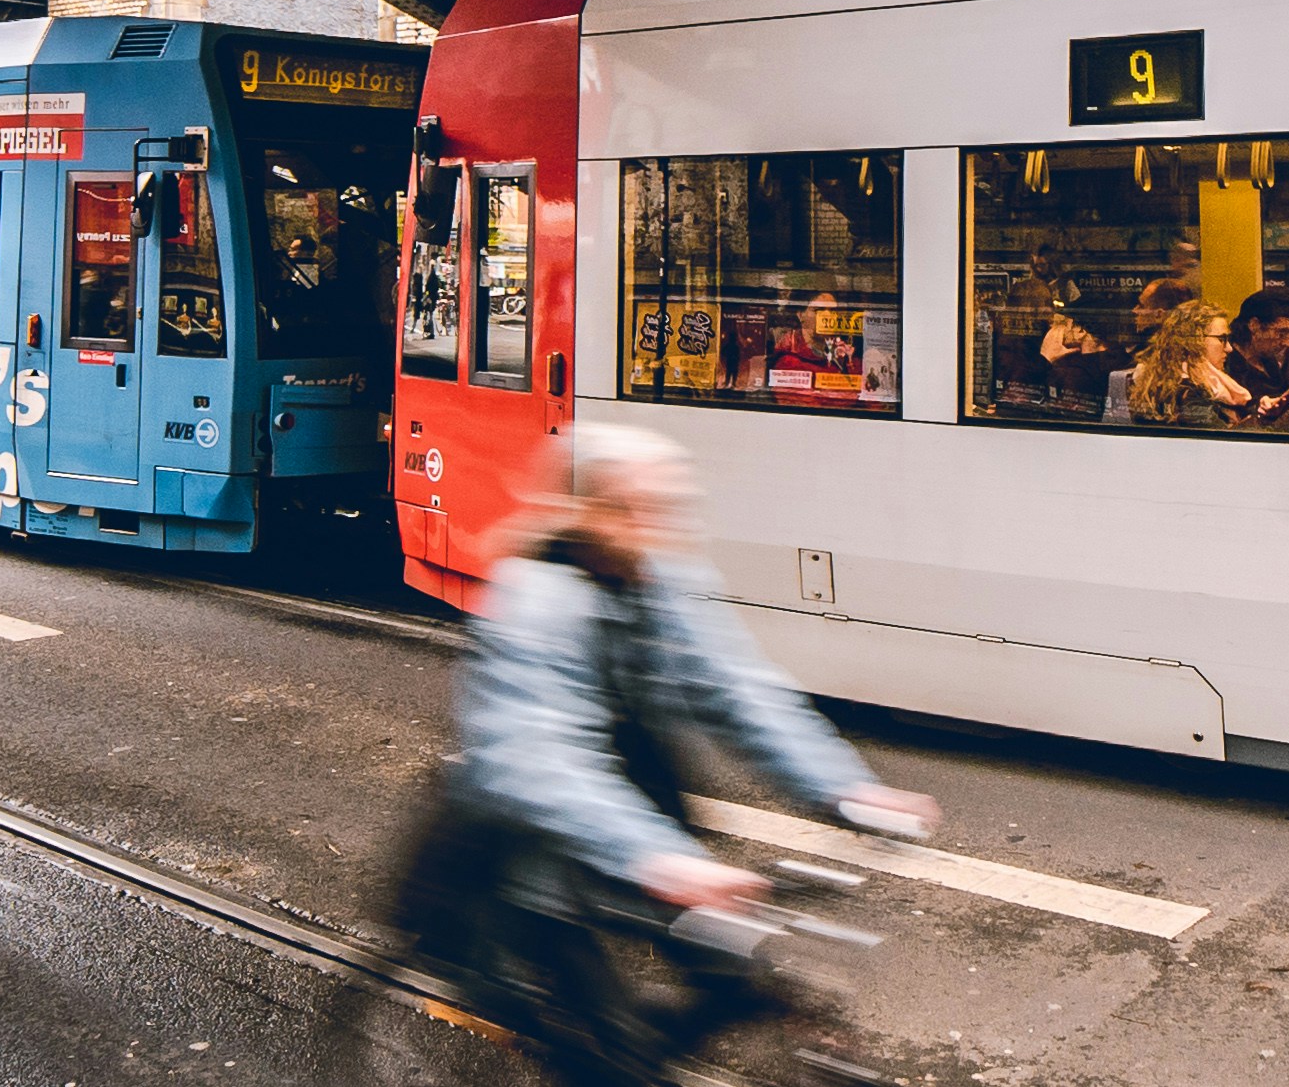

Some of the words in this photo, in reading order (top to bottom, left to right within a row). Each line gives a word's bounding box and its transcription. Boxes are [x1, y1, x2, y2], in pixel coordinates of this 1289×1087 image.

[241, 49, 260, 93] 9
[275, 56, 417, 94] Königsforst
[1129, 49, 1156, 105] 9
[1119, 277, 1143, 287] BOA
[165, 421, 195, 440] KVB
[404, 451, 426, 472] KVB
